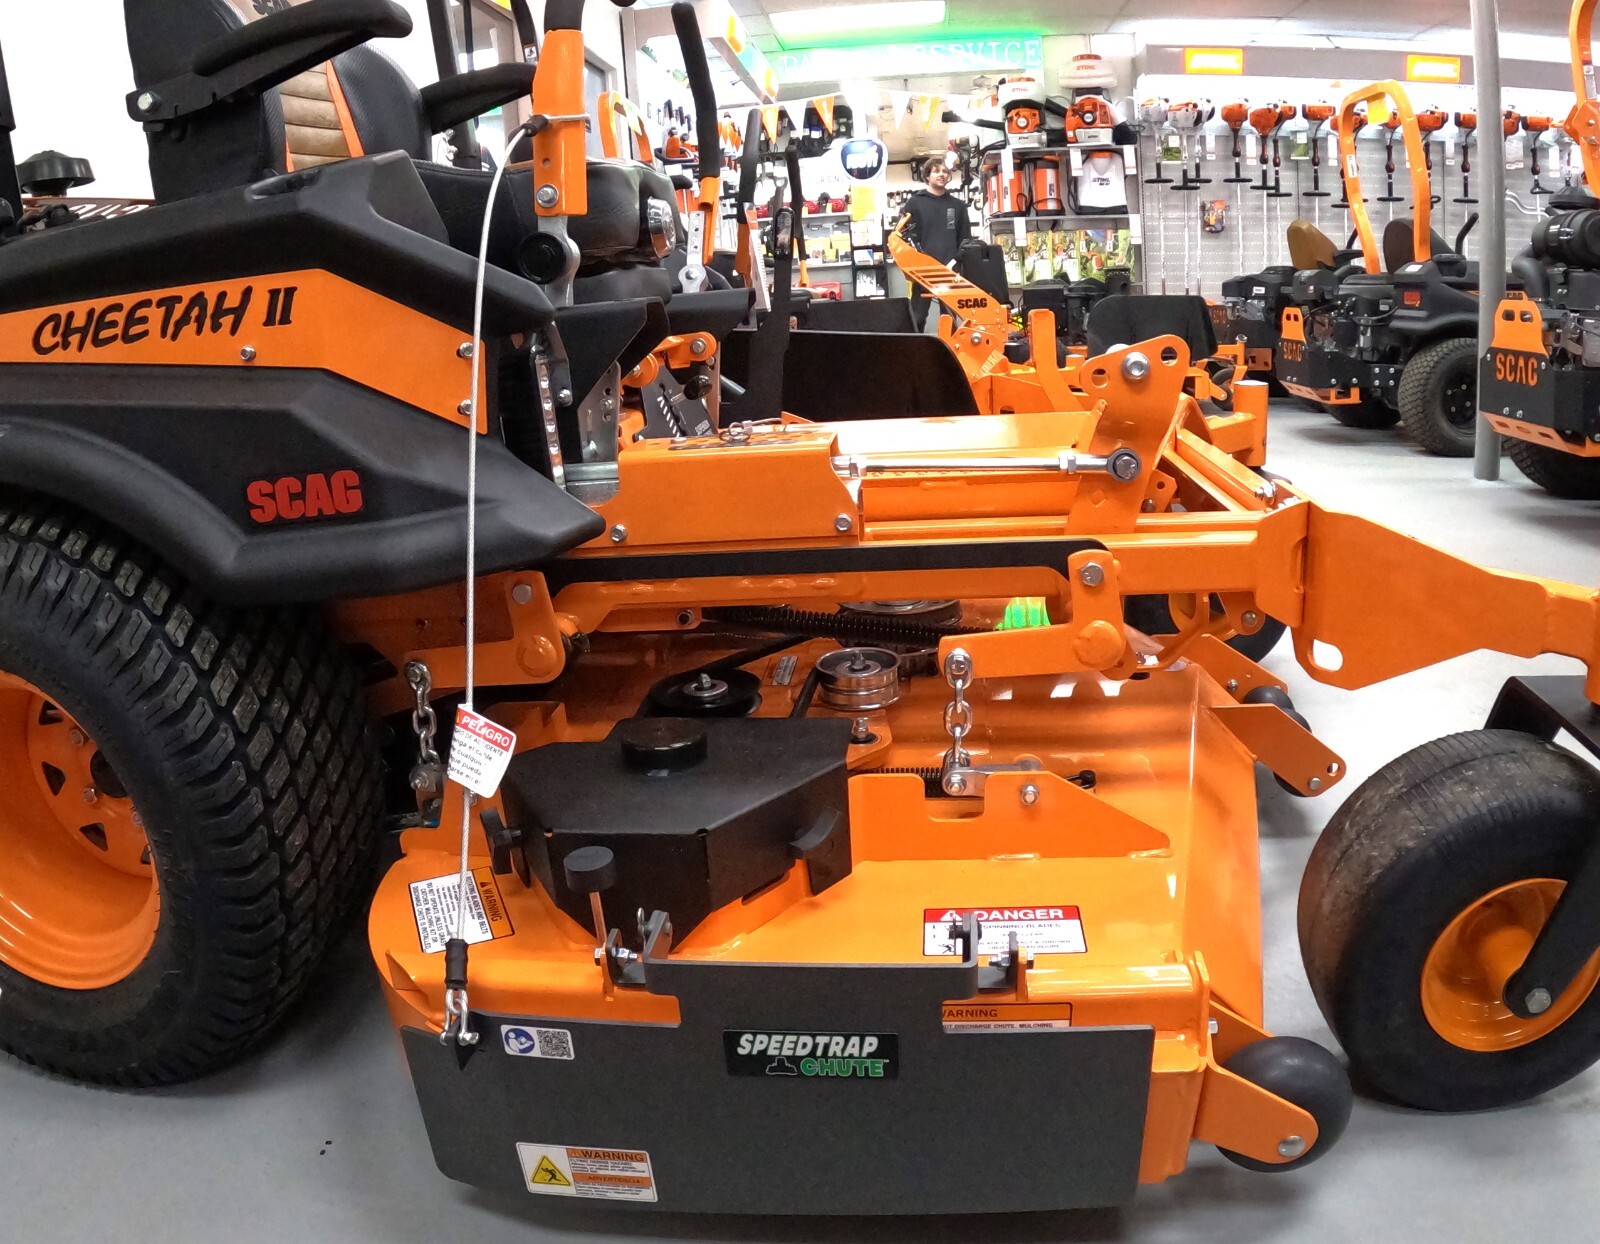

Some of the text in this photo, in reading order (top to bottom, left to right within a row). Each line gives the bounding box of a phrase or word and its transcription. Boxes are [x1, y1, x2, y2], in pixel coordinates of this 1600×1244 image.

[957, 298, 988, 309] SCAG
[32, 285, 298, 355] CHEETAH II
[1495, 351, 1538, 386] SCAG
[245, 469, 363, 523] SCAG
[461, 715, 510, 747] PELIGRO
[483, 888, 502, 922] WARNING
[974, 908, 1064, 920] DANGER
[736, 1033, 879, 1057] SPEEDTRAP
[800, 1057, 884, 1077] CHUTE
[580, 1150, 644, 1161] WARNING
